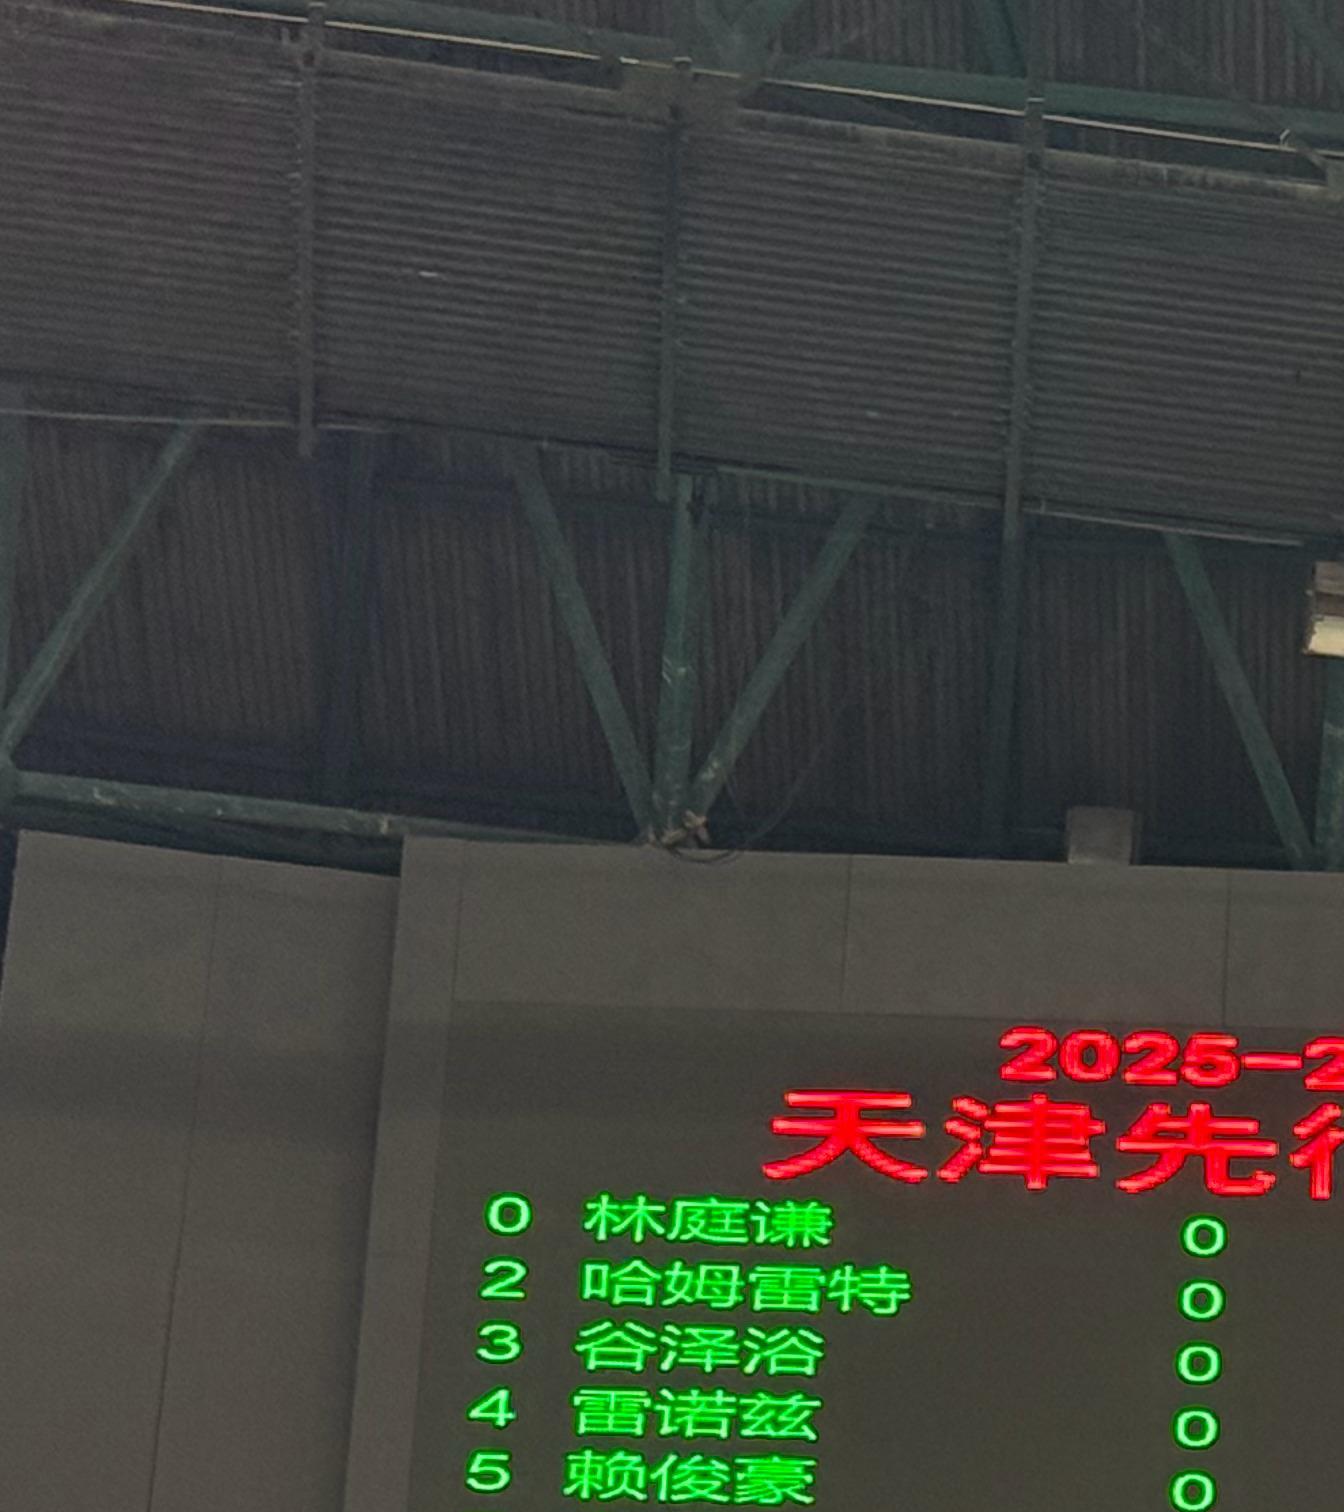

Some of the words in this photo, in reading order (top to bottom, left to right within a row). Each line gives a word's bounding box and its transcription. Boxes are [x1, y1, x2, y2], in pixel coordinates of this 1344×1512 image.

[485, 1193, 532, 1234] 0
[583, 1192, 834, 1248] 林庭谦
[1182, 1216, 1226, 1256] 0
[480, 1257, 527, 1299] 2
[580, 1258, 911, 1316] 哈姆雷特
[1179, 1280, 1224, 1320] 0
[479, 1321, 522, 1362] 3
[574, 1319, 823, 1376] 谷泽浴
[1176, 1342, 1220, 1383] 0
[468, 1388, 515, 1427] 4
[571, 1387, 820, 1440] 雷诺兹
[1173, 1408, 1218, 1447] 0
[467, 1450, 511, 1491] 5
[563, 1448, 816, 1505] 赖俊豪
[1169, 1471, 1215, 1512] 0
